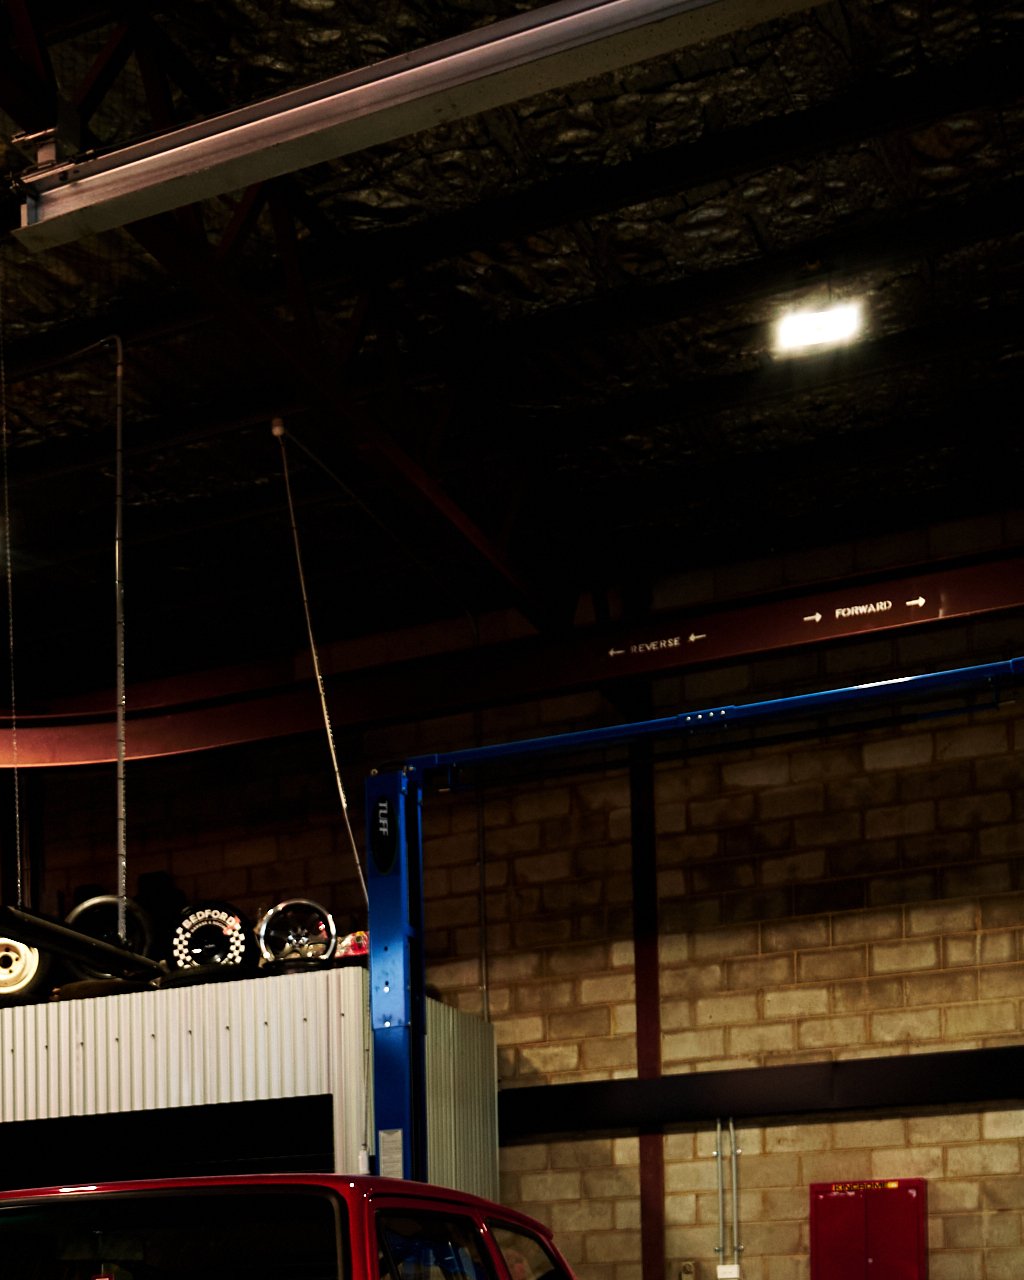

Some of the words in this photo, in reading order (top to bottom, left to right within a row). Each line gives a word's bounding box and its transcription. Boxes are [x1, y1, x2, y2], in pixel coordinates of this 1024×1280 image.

[835, 600, 893, 619] FORWARD
[630, 637, 681, 654] REVERSE
[378, 800, 389, 837] TUFF
